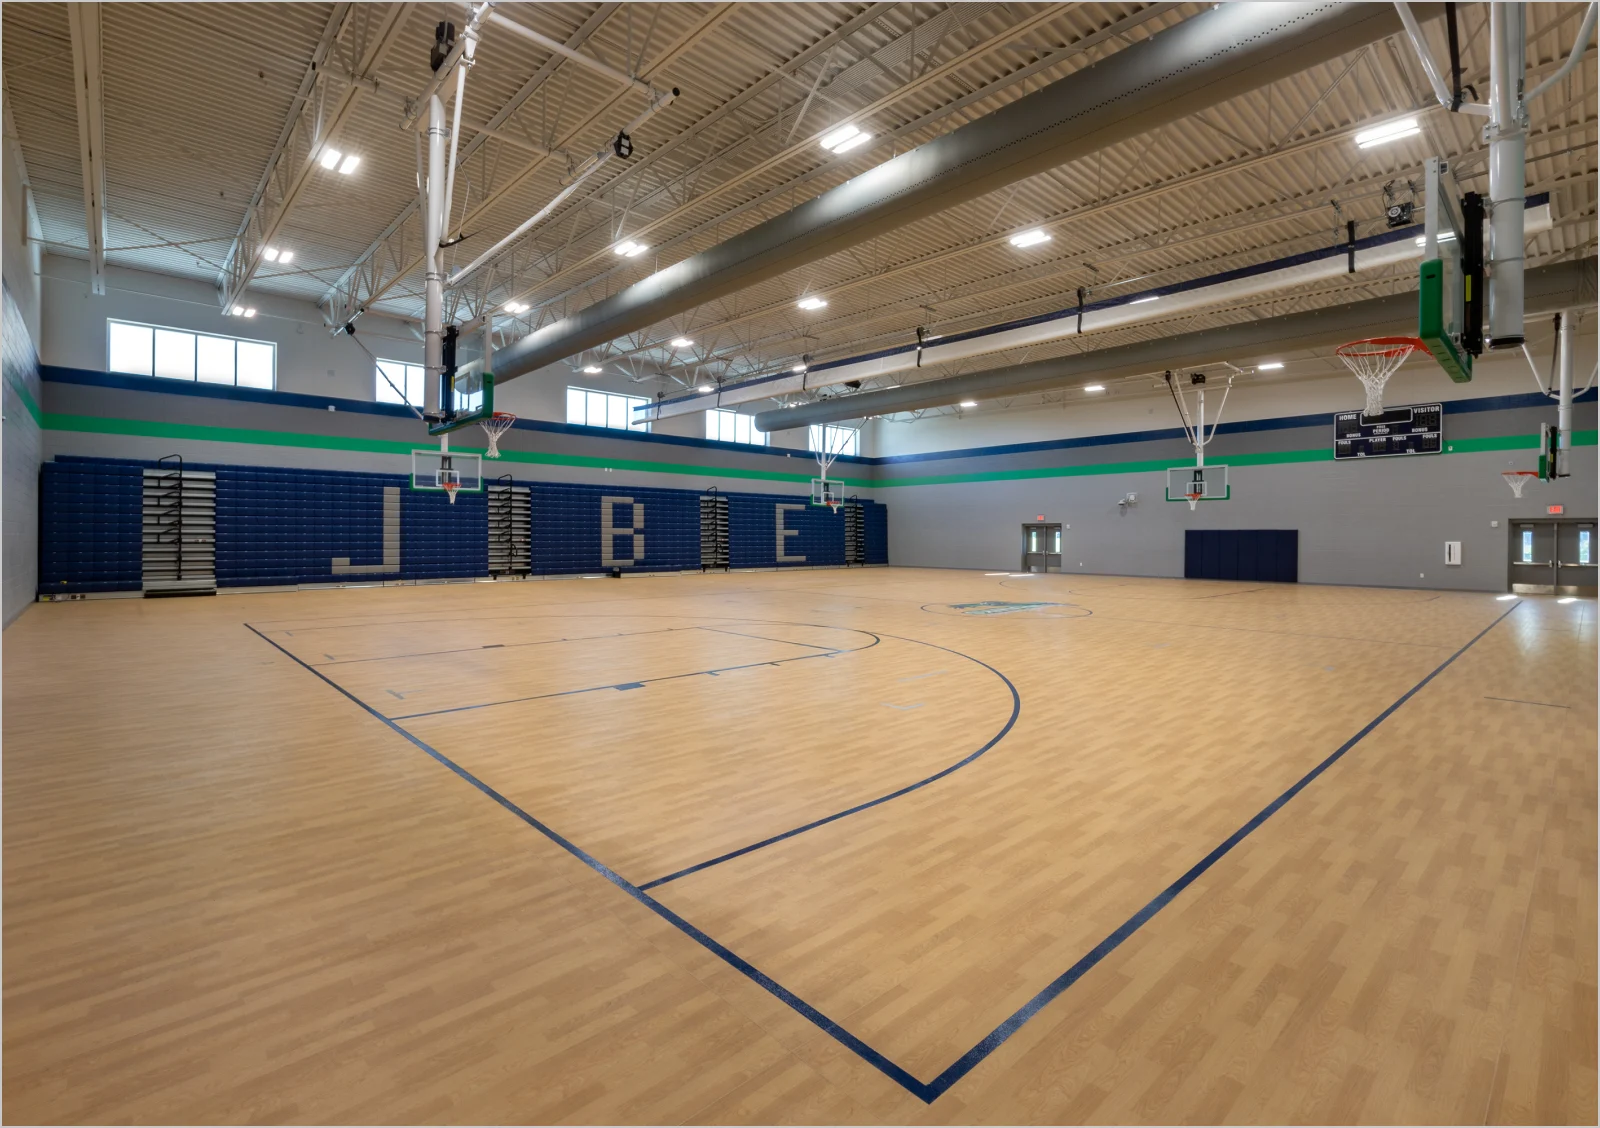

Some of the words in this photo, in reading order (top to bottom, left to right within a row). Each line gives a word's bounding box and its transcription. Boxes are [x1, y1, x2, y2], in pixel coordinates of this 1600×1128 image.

[332, 486, 400, 575] J
[601, 496, 645, 567] B
[776, 503, 806, 563] E
